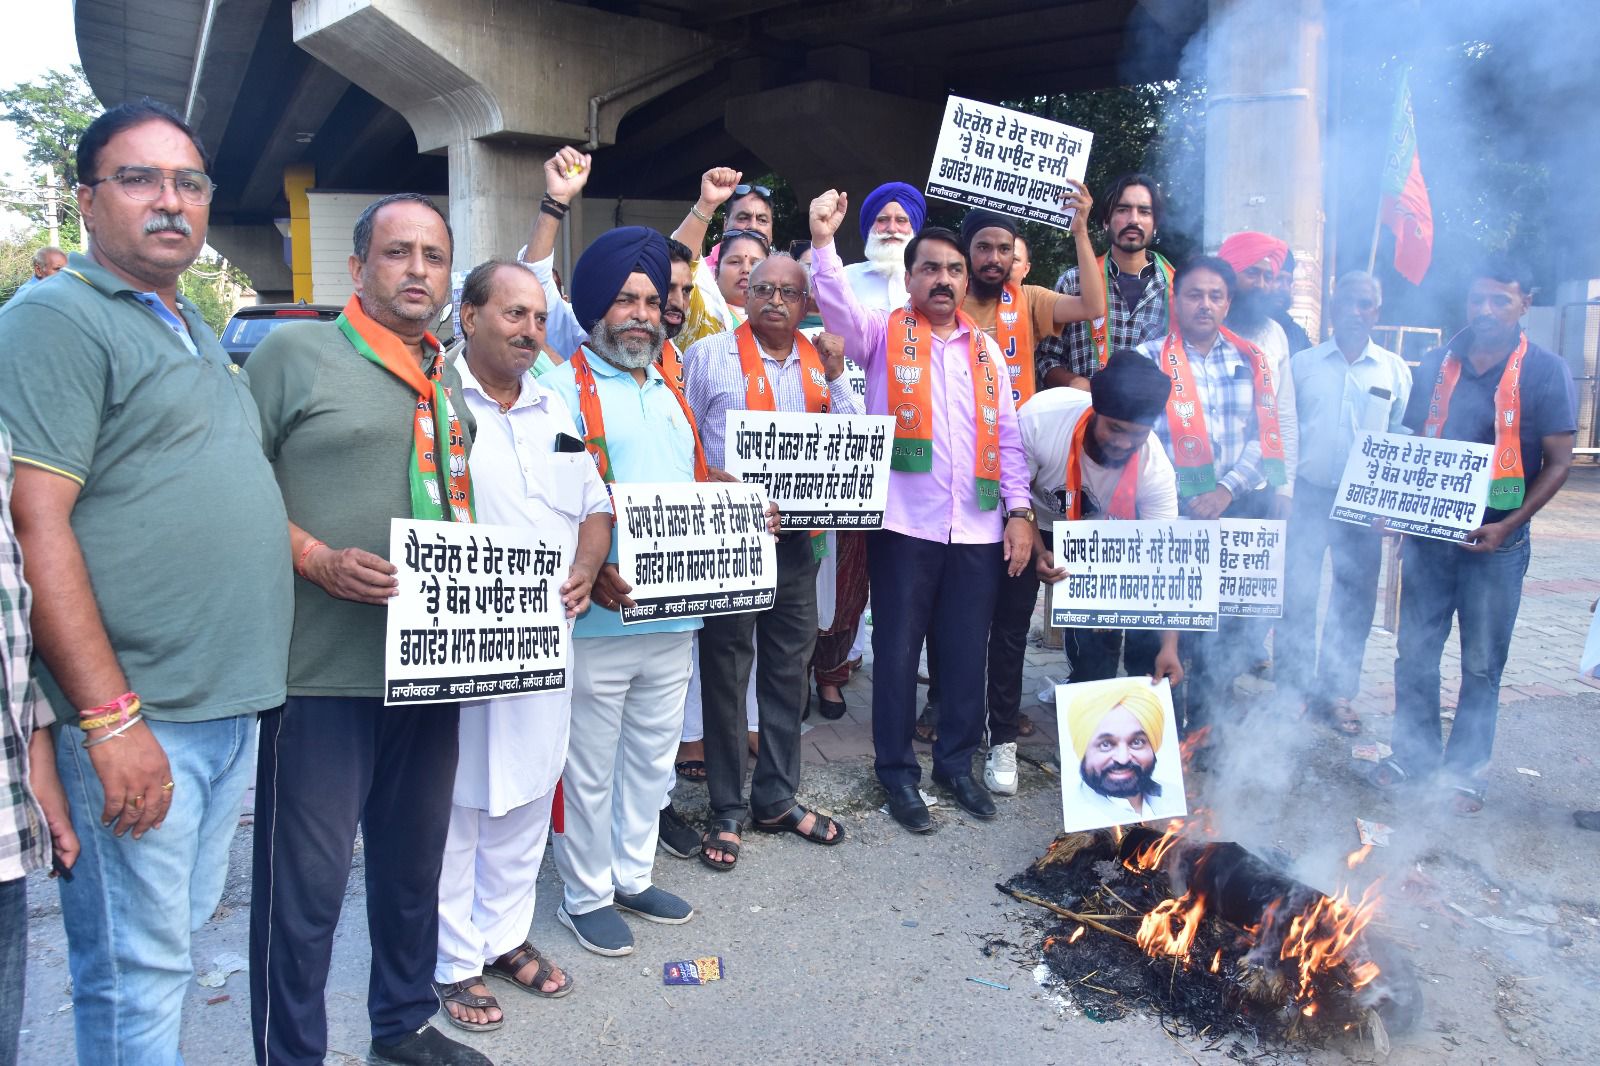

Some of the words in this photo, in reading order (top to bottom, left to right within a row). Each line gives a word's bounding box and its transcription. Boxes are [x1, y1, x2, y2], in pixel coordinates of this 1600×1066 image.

[953, 103, 993, 134] ਪੈਟਰੋਲ
[996, 116, 1006, 138] ਦੇ
[1009, 119, 1027, 143] ਰੇਟ
[1030, 129, 1053, 149] ਵਧਾ
[1056, 132, 1082, 157] ਲੋਕਾਂ
[975, 134, 995, 159] ਬੋਜ
[998, 145, 1035, 171] ਪਾਉਣ
[1038, 155, 1068, 177] ਵਾਲੀ
[939, 156, 973, 183] ਭਗਵੰਤ
[973, 165, 994, 188] ਮਾਨ
[994, 170, 1028, 196] ਸਰਕਾਰ
[931, 186, 961, 198] ਜਾਰੀਕਰਤਾ
[968, 195, 986, 206] ਭਾਰਤੀ
[988, 200, 1006, 210] ਜਨਤਾ
[1007, 205, 1026, 215] ਪਾਰਟੀ,
[1029, 209, 1048, 220] ਜਲੰਧਰ
[1005, 337, 1016, 358] J
[736, 421, 762, 459] ਪੰਜਾਬ
[765, 422, 776, 460] ਦੀ
[779, 432, 803, 460] ਜਨਤਾ
[805, 423, 822, 461] ਨਵੇਂ
[845, 421, 869, 461] ਟੈਕਸਾਂ
[1362, 435, 1399, 461] ਪੈਟਰੋਲ
[1402, 442, 1412, 462] ਦੇ
[1414, 444, 1431, 465] ਰੇਟ
[1434, 451, 1457, 468] ਵਧਾ
[1459, 449, 1488, 472] ਲੋਕਾਂ
[773, 472, 792, 499] ਮਾਨ
[793, 472, 824, 499] ਸਰਕਾਰ
[825, 464, 839, 507] ਲੁੱਟ
[841, 465, 858, 499] ਰਹੀ
[859, 464, 874, 507] ਬੁੱਲੇ
[1403, 467, 1437, 491] ਪਾਉਣ
[1441, 472, 1472, 493] ਵਾਲੀ
[626, 496, 652, 538] ਪੰਜਾਬ
[653, 494, 665, 538] ਦੀ
[665, 504, 690, 536] ਜਨਤਾ
[691, 493, 705, 535] ਨਵੇਂ
[726, 489, 750, 533] ਟੈਕਸਾਂ
[791, 515, 811, 524] ਜਨਤਾ
[813, 514, 834, 525] ਪਾਰਟੀ,
[837, 515, 859, 524] ਜਲੰਧਰ
[1346, 481, 1378, 505] ਭਗਵੰਤ
[1378, 489, 1398, 510] ਮਾਨ
[1398, 492, 1431, 515] ਸਰਕਾਰ
[1430, 496, 1476, 523] ਮੁਰਦਾਬਾਦ
[405, 529, 462, 574] ਪੈਟਰੋਲ
[467, 536, 478, 574] ਦੇ
[483, 536, 503, 574] ਰੇਟ
[508, 548, 530, 575] ਵਧਾ
[534, 540, 561, 576] ਲੋਕਾਂ
[1063, 531, 1086, 563] ਪੰਜਾਬ
[1089, 530, 1099, 563] ਦੀ
[1101, 539, 1125, 563] ਜਨਤਾ
[1128, 529, 1144, 563] ਨਵੇਂ
[1168, 526, 1192, 564] ਟੈਕਸਾਂ
[1233, 531, 1253, 547] ਵਧਾ
[1257, 526, 1279, 547] ਲੋਕਾਂ
[636, 542, 664, 585] ਭਗਵੰਤ
[666, 551, 684, 583] ਮਾਨ
[687, 549, 715, 581] ਸਰਕਾਰ
[717, 538, 730, 588] ਲੁੱਟ
[733, 537, 747, 578] ਰਹੀ
[749, 535, 762, 585] ਬੁੱਲੇ
[1243, 549, 1270, 570] ਵਾਲੀ
[447, 575, 470, 614] ਬੋਜ
[475, 577, 515, 621] ਪਾਉਣ
[520, 578, 547, 613] ਵਾਲੀ
[665, 599, 686, 613] ਭਾਰਤੀ
[688, 600, 708, 611] ਜਨਤਾ
[733, 594, 753, 607] ਜਲੰਧਰ
[1069, 567, 1097, 599] ਭਗਵੰਤ
[1100, 574, 1117, 599] ਮਾਨ
[1120, 574, 1149, 600] ਸਰਕਾਰ
[1152, 567, 1165, 607] ਲੁੱਟ
[1168, 567, 1184, 600] ਰਹੀ
[1187, 567, 1202, 608] ਬੁੱਲੇ
[1238, 577, 1277, 602] ਮੁਰਦਾਬਾਦ
[1056, 613, 1090, 623] ਜਾਰੀਕਰਤਾ
[1097, 613, 1118, 624] ਭਾਰਤੀ
[1120, 616, 1140, 624] ਜਨਤਾ
[1143, 615, 1165, 625] ਪਾਰਟੀ,
[1167, 616, 1189, 625] ਜਲੰਧਰ
[400, 617, 448, 665] ਭਗਵੰਤ
[452, 628, 475, 664] ਮਾਨ
[479, 627, 514, 662] ਸਰਕਾਰ
[517, 626, 559, 669] ਮੁਰਦਾਬਾਦ
[392, 683, 440, 697] ਜਾਰੀਕਰਤਾ
[450, 680, 475, 695] ਭਾਰਤੀ
[476, 680, 497, 693] ਜਨਤਾ
[499, 676, 521, 690] ਪਾਰਟੀ,
[523, 674, 543, 688] ਜਲੰਧਰ
